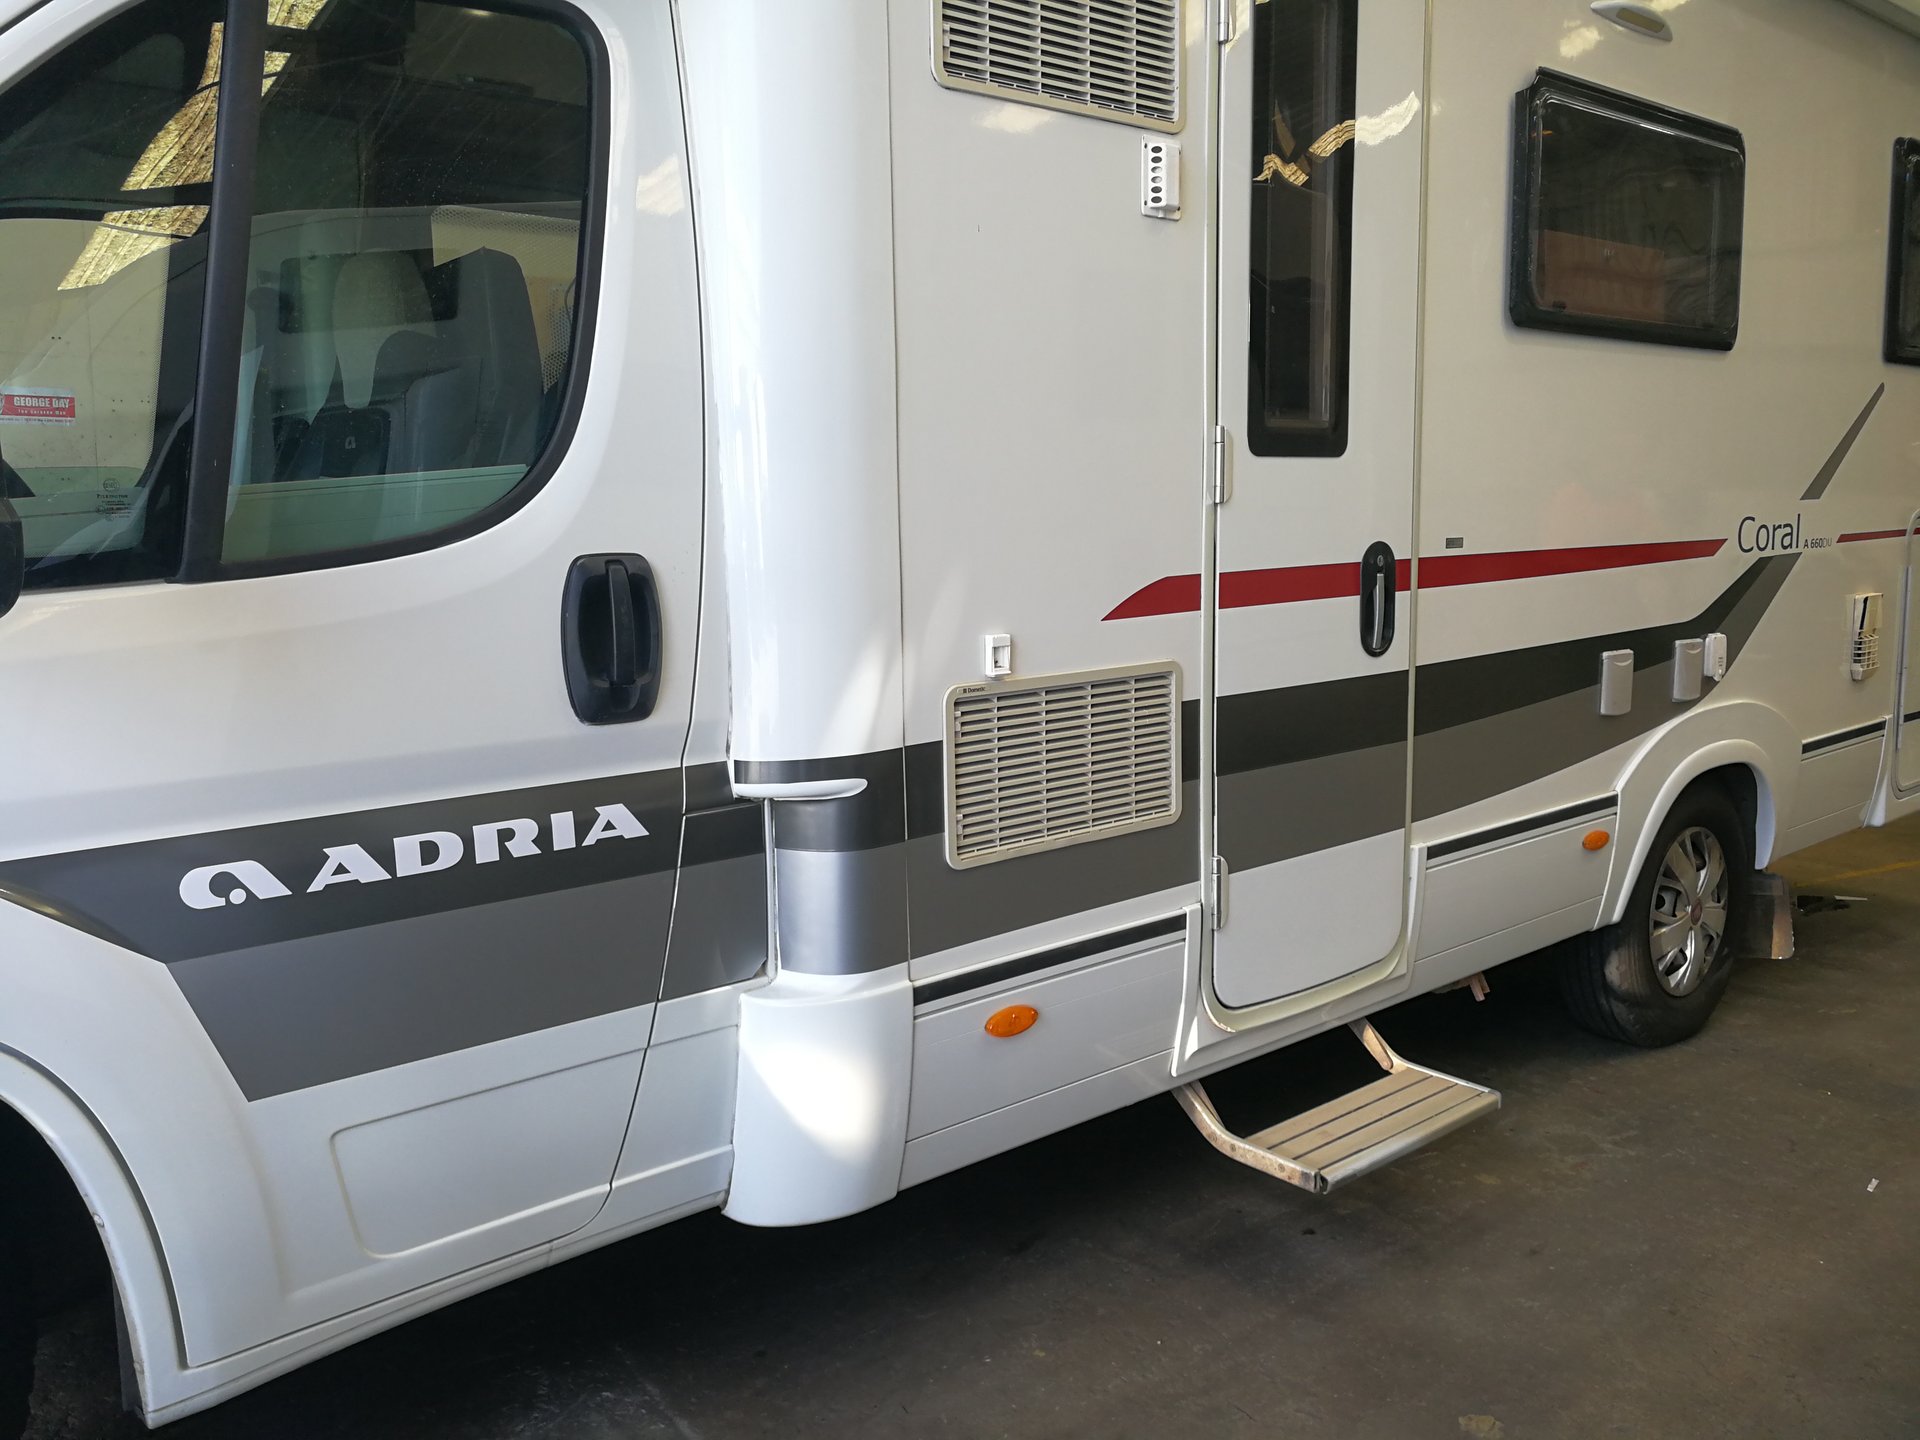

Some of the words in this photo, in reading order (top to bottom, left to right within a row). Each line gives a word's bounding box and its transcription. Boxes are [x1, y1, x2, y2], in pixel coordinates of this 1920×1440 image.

[13, 396, 51, 407] GEORGE
[52, 398, 70, 408] DAY
[1738, 513, 1801, 553] Coral
[1803, 539, 1809, 549] A
[306, 803, 650, 893] ADRIA
